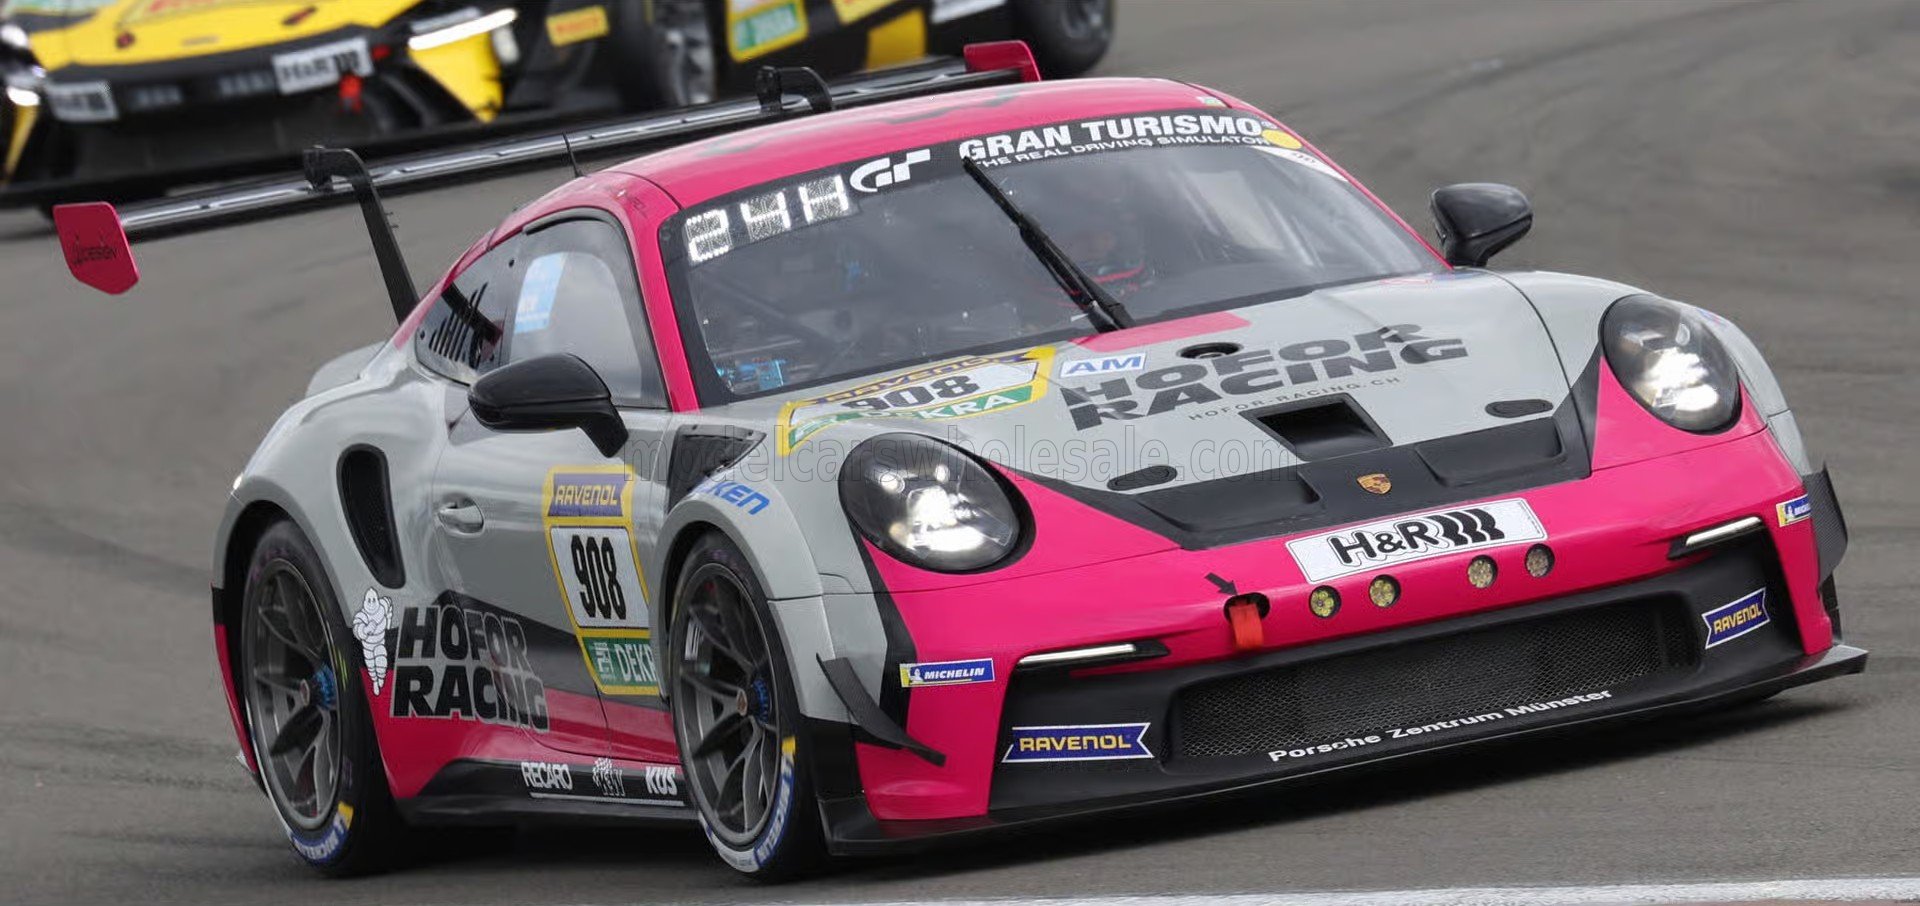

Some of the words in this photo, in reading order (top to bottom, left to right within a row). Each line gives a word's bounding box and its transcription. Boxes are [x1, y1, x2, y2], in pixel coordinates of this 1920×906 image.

[959, 125, 1072, 160] GRAN
[1081, 115, 1262, 142] TURISMO
[1015, 149, 1069, 163] REAL
[1071, 137, 1153, 153] DRIVING
[1156, 135, 1270, 147] SIMULATOR
[850, 150, 930, 192] GT
[1060, 324, 1437, 406] HOFOR
[1066, 354, 1142, 373] AM
[841, 375, 980, 411] 908
[1067, 339, 1468, 431] RACING
[555, 484, 618, 507] RAVENOL
[1329, 520, 1441, 565] H&R
[570, 534, 626, 620] 908
[396, 604, 535, 675] HOFOR
[1713, 603, 1762, 635] RAVENOL
[614, 643, 657, 683] DEKR
[924, 667, 985, 680] MICHELIN
[392, 663, 550, 731] RACING
[1019, 734, 1132, 752] RAVENOL
[1268, 733, 1382, 762] Porsche
[1385, 710, 1504, 739] Zentrum
[1504, 689, 1613, 716] Münster
[521, 762, 573, 790] RECARO
